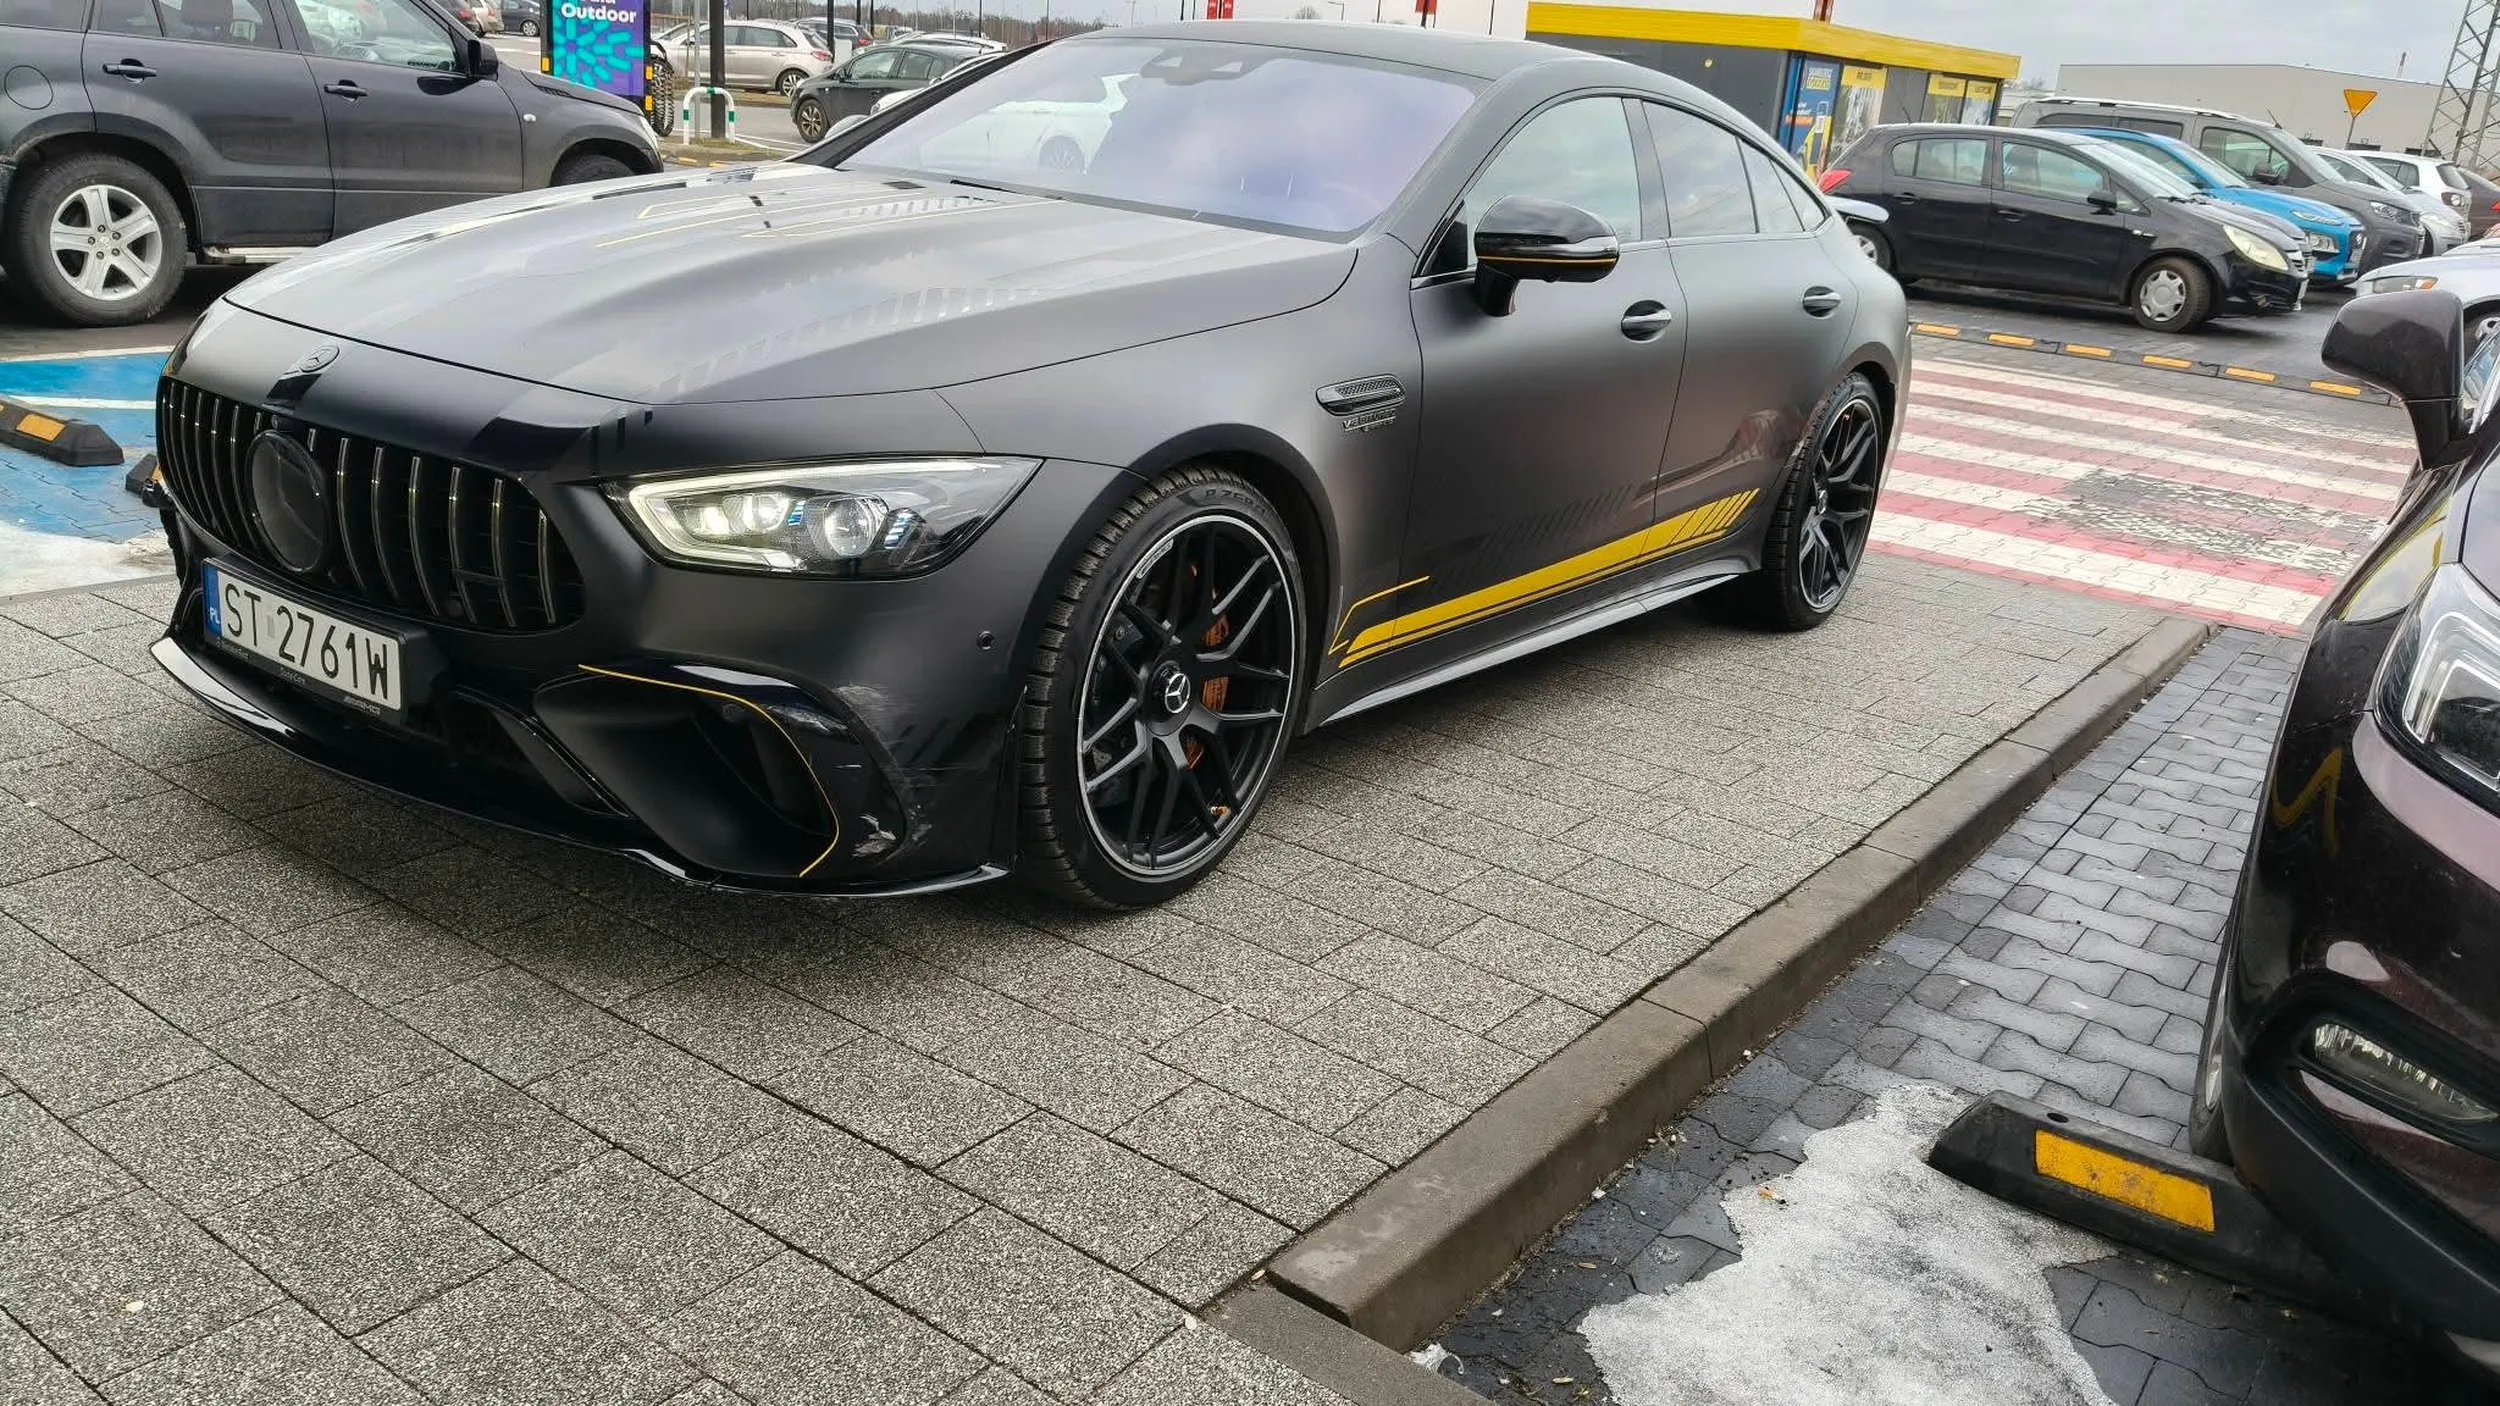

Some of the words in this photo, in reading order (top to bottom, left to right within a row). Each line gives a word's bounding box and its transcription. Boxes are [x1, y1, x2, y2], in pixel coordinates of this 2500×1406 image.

[561, 3, 637, 23] Outdoor
[209, 606, 220, 625] PL
[224, 583, 261, 647] ST
[276, 605, 388, 700] 2761W
